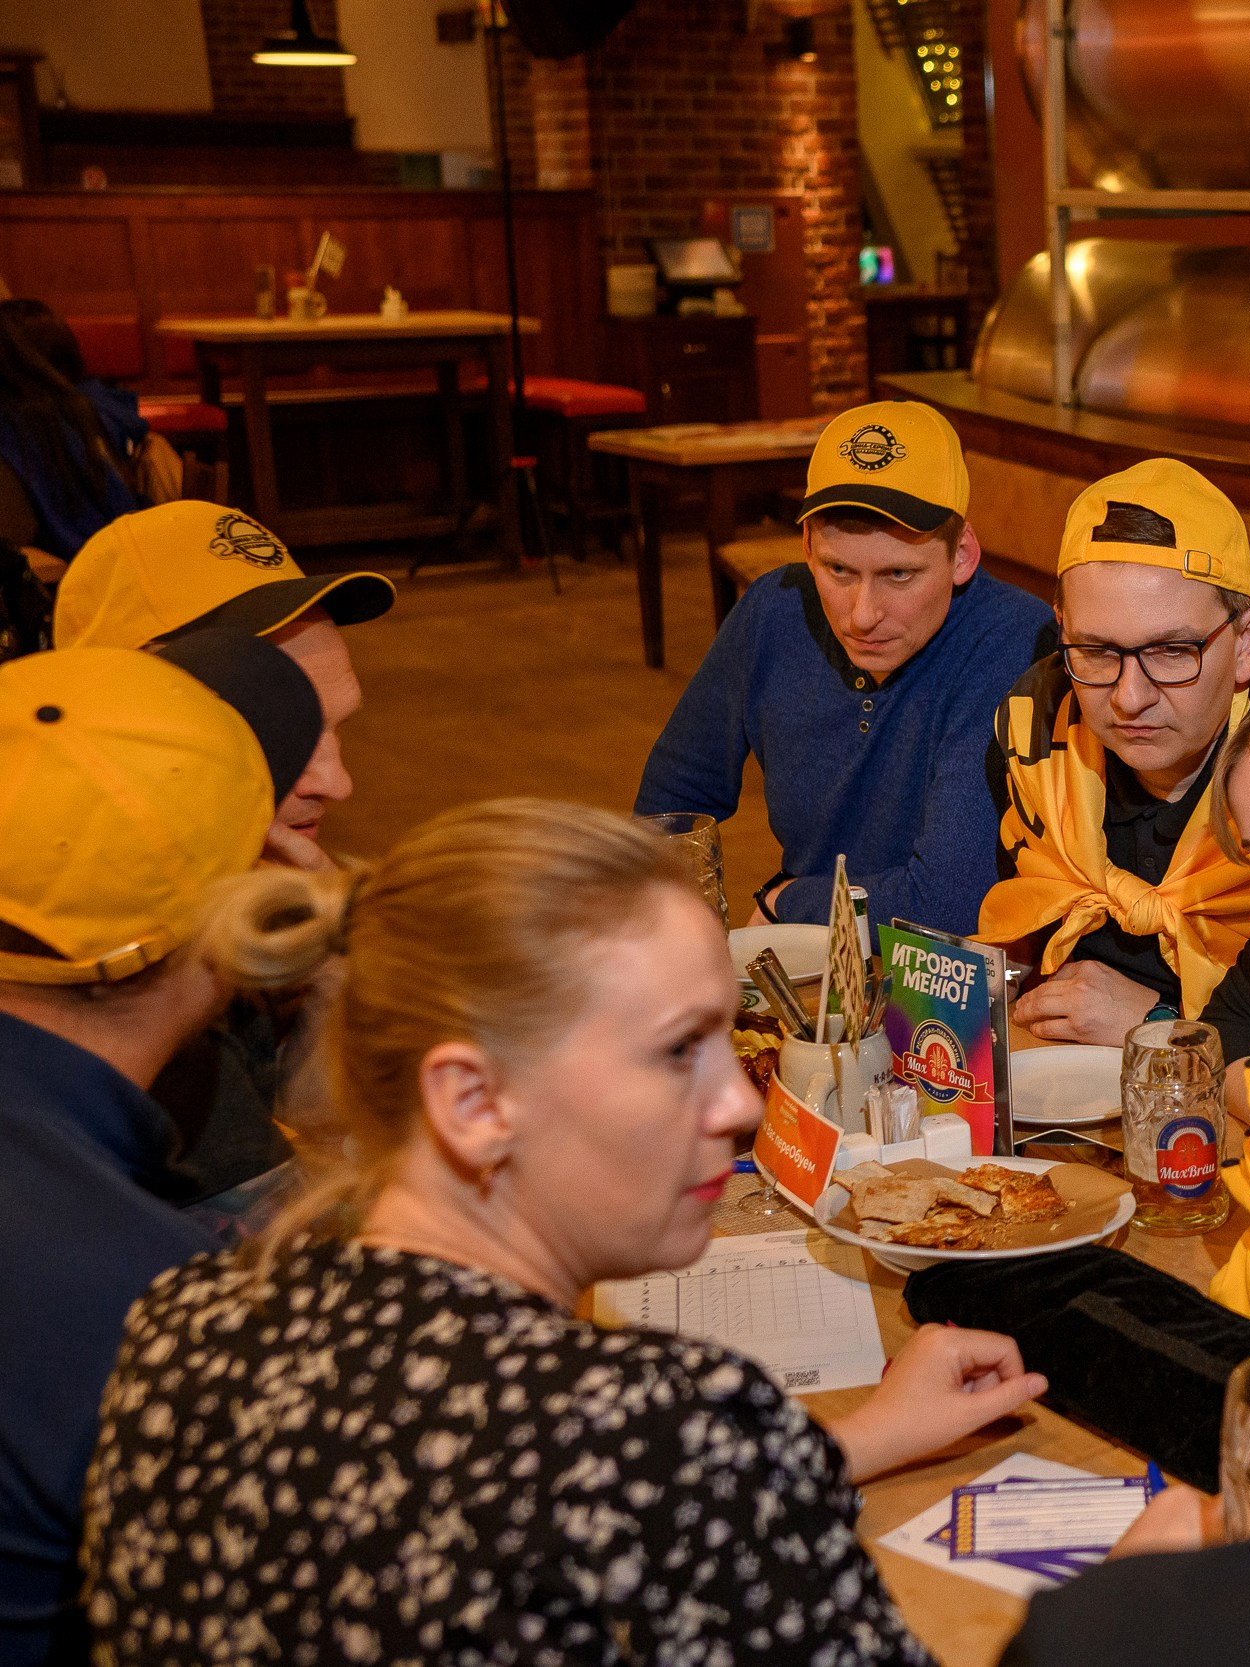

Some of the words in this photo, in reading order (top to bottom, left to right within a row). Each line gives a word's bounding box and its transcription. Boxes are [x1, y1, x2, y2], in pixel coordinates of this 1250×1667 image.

[891, 942, 977, 985] ИГРОВОЕ
[903, 967, 969, 1011] МЕНЮ!
[906, 1056, 928, 1074] Max
[947, 1069, 972, 1089] Bräu
[774, 1135, 817, 1175] переОбуем
[1160, 1163, 1215, 1179] MaxBräu
